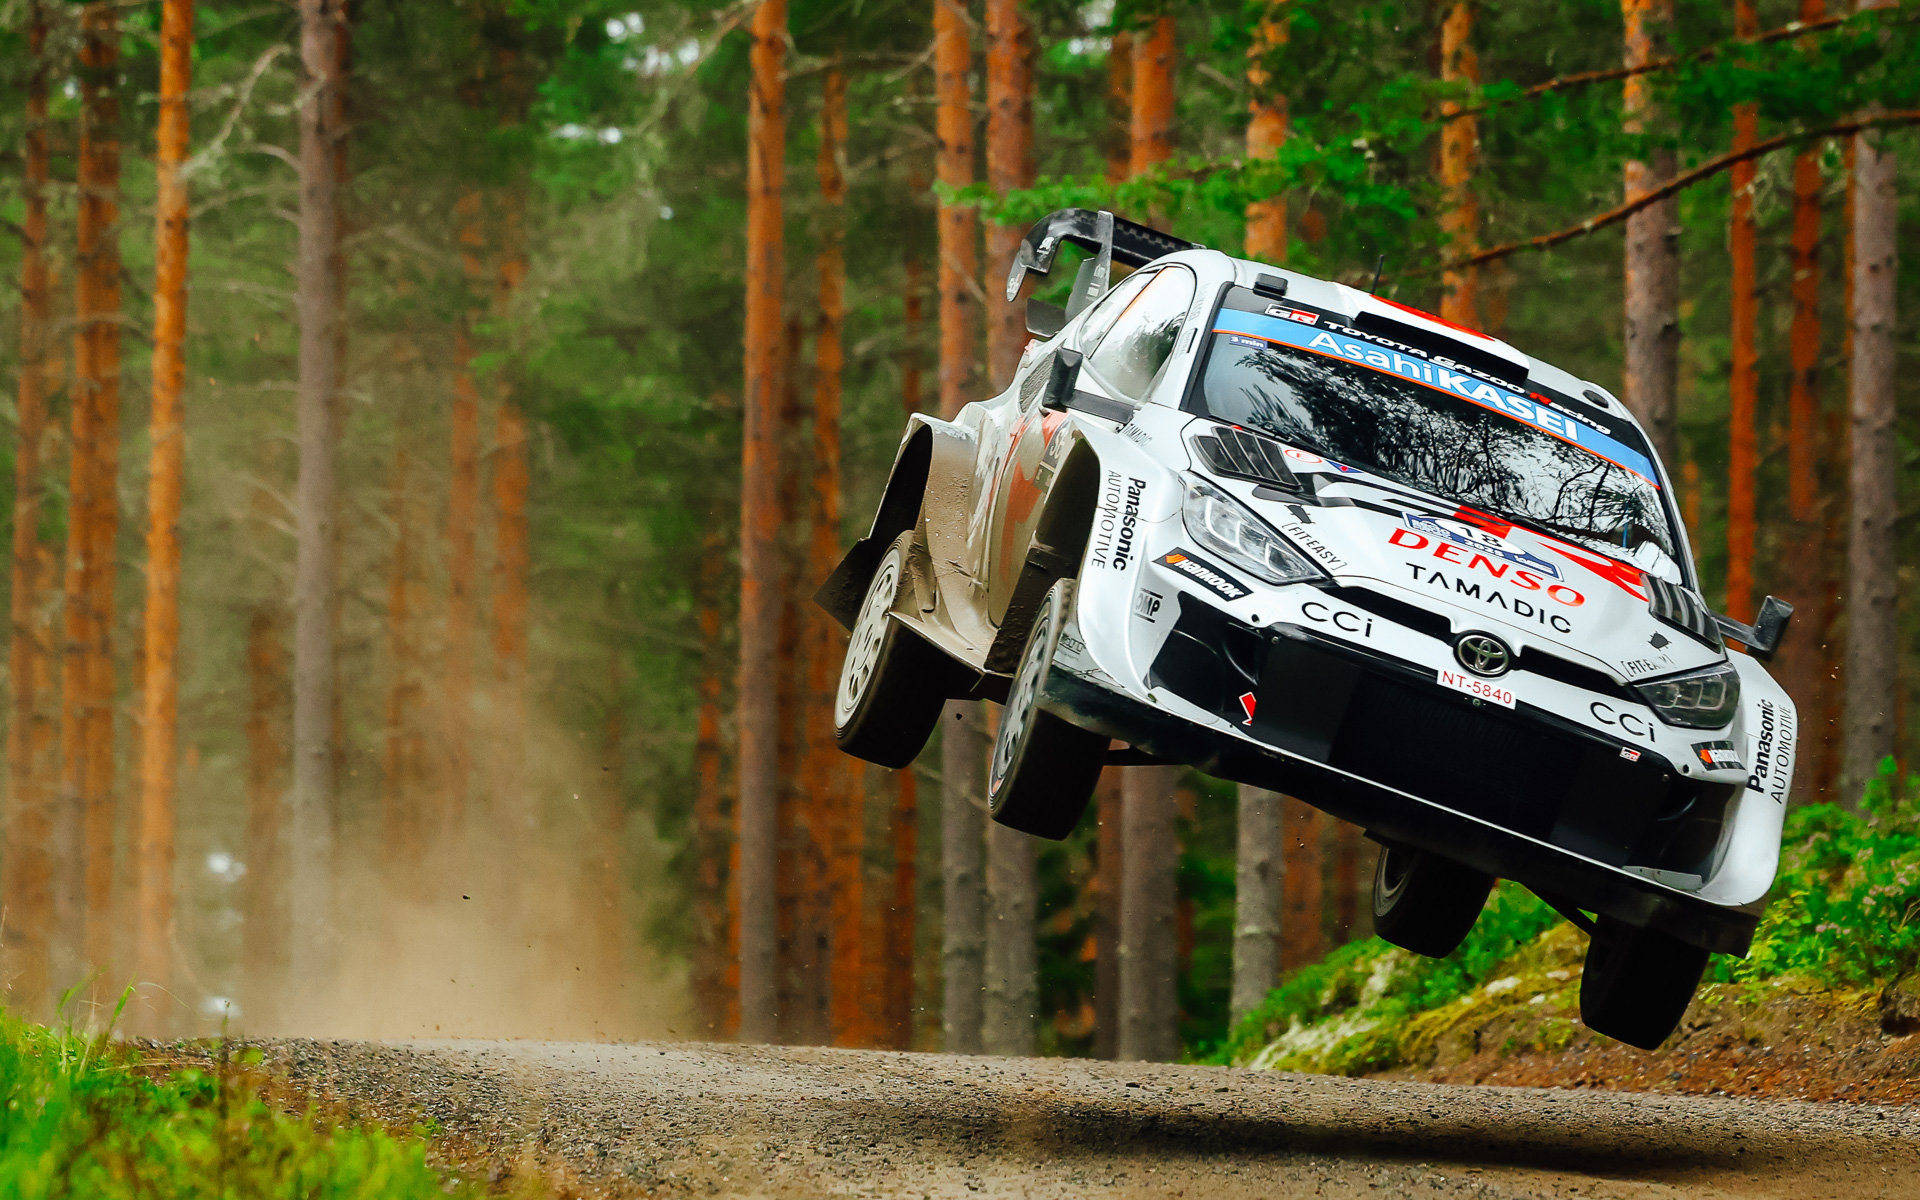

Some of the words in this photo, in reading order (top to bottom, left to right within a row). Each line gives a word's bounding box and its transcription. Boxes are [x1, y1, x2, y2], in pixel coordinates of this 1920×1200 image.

[1241, 339, 1264, 348] min
[1266, 304, 1319, 325] GR
[1324, 320, 1428, 358] TOYOTA
[1429, 355, 1525, 394] GAZOO
[1530, 392, 1612, 435] Racing
[1091, 470, 1122, 569] AUTOMOTIVE
[1112, 477, 1146, 571] Panasonic
[1460, 526, 1502, 548] 18
[1464, 539, 1504, 557] 2025
[1135, 592, 1160, 616] OMP
[1388, 527, 1585, 607] DENSO
[1406, 562, 1572, 634] TAMADIC
[1442, 671, 1512, 704] NT-5840
[1746, 699, 1774, 794] Panasonic
[1770, 705, 1792, 804] AUTOMOTIVE
